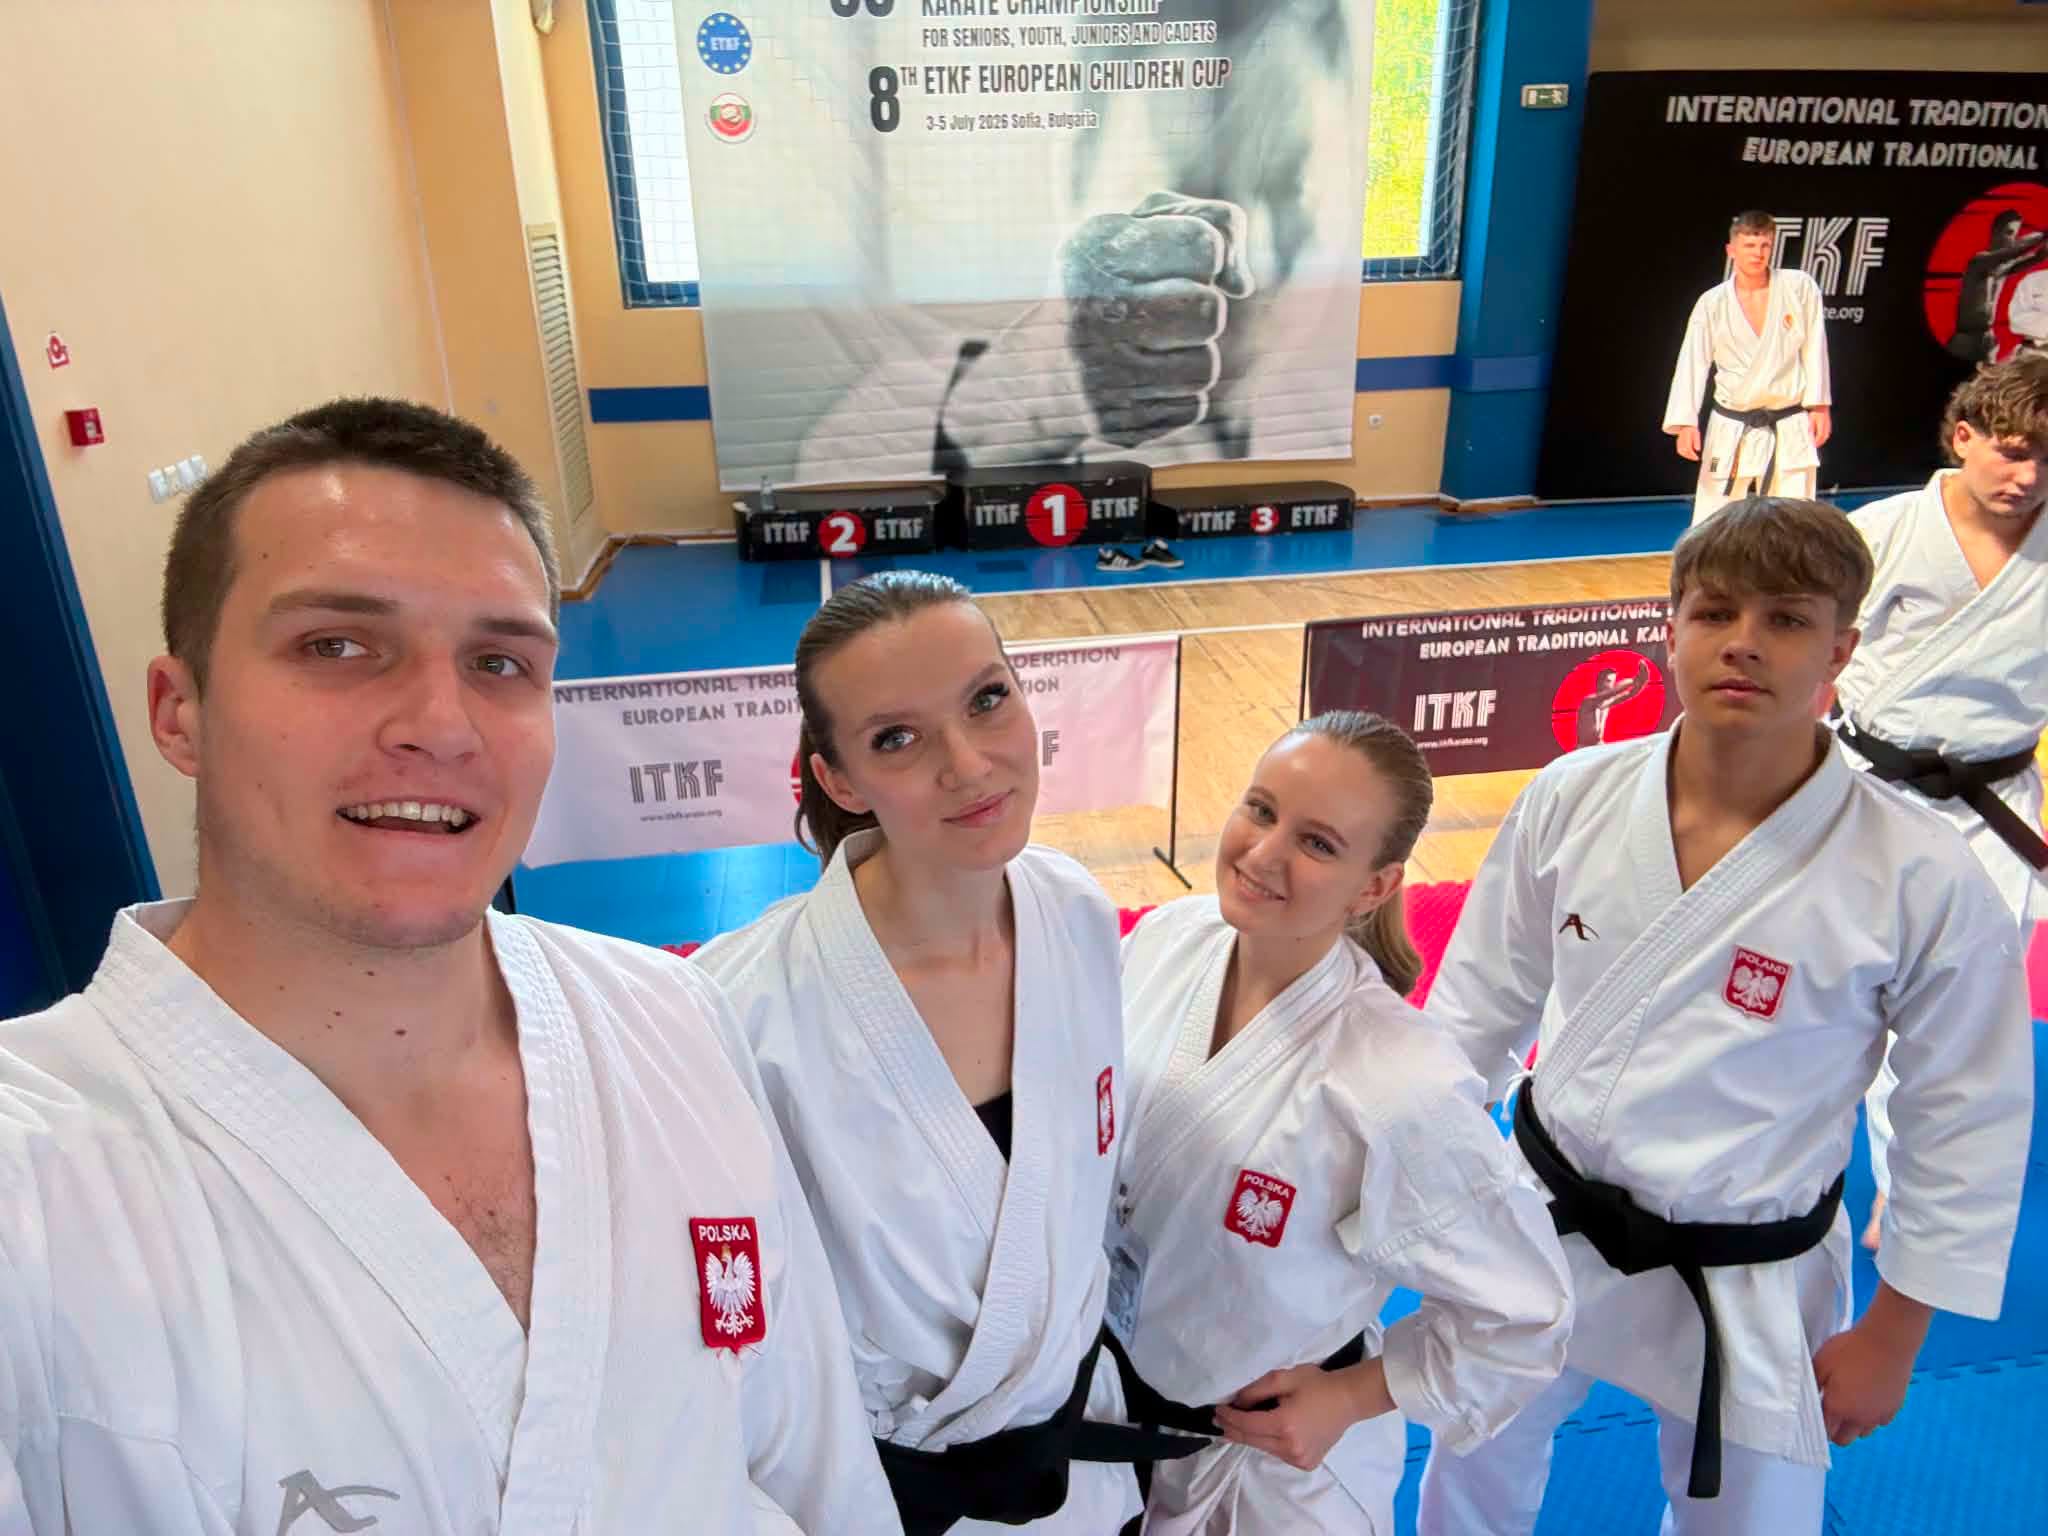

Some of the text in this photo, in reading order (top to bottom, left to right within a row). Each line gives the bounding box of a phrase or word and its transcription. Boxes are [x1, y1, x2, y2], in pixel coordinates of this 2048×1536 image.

[923, 21, 1216, 48] FOR SENIORS, YOUTH, JUNIORS AND CADETS
[925, 66, 971, 94] ETKF
[980, 63, 1082, 93] EUROPEAN
[1090, 60, 1185, 91] CHILDREN
[1192, 58, 1230, 88] CUP
[926, 115, 947, 131] 3-5
[950, 114, 975, 132] July
[978, 113, 1008, 130] 2026
[1048, 111, 1097, 129] Bulgaria
[1666, 95, 2048, 128] INTERNATIONAL TRADITION
[1742, 137, 2039, 170] EUROPEAN TRADITIONAL
[975, 494, 1138, 536] ITKF 1 ETKF
[1192, 504, 1338, 532] ITKF 3 ETKF
[763, 516, 923, 552] ITKF 2 ETKF
[1362, 612, 1526, 639] INTERNATIONAL
[1533, 601, 1662, 626] TRADITIONAL
[1420, 637, 1510, 660] EUROPEAN
[1517, 627, 1629, 653] TRADITIONAL
[553, 677, 738, 704] NTERNATIONAL
[622, 710, 725, 726] EUROPEAN
[1414, 689, 1497, 732] ITKF
[629, 759, 723, 804] ITKF
[1738, 950, 1787, 975] POLAND
[1242, 1173, 1290, 1199] POLSKA
[698, 1224, 751, 1243] POLSKA
